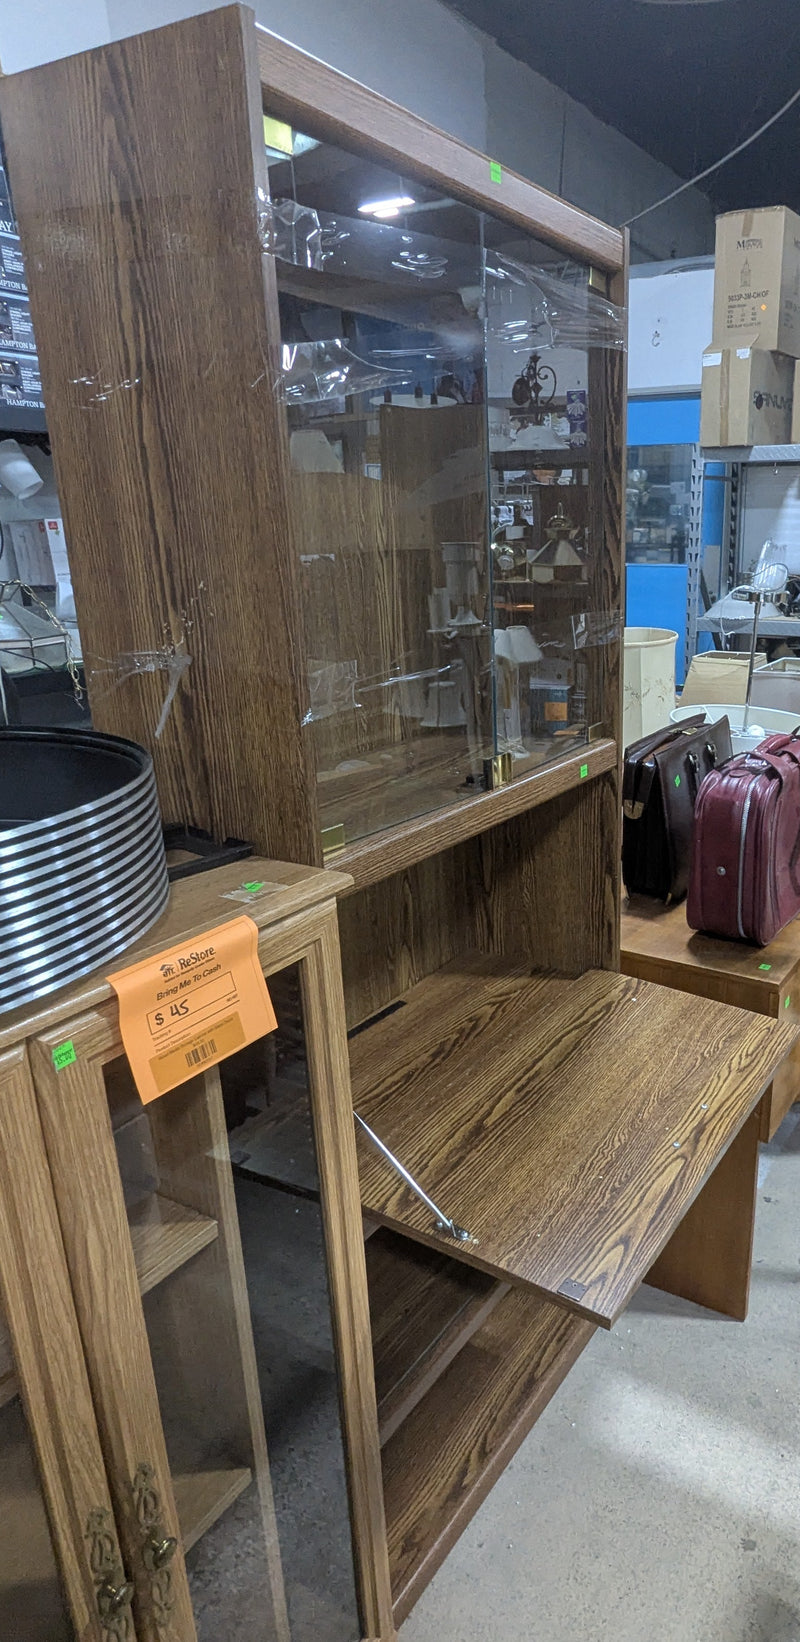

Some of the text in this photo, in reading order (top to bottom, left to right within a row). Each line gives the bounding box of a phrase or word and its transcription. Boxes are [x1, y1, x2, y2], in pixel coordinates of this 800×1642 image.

[0, 339, 28, 349] AMPTON
[6, 398, 39, 408] HAMPTON
[178, 947, 215, 970] ReStore
[156, 963, 222, 1001] Bring Me To Cash
[170, 999, 190, 1016] 45
[154, 1012, 165, 1026] $
